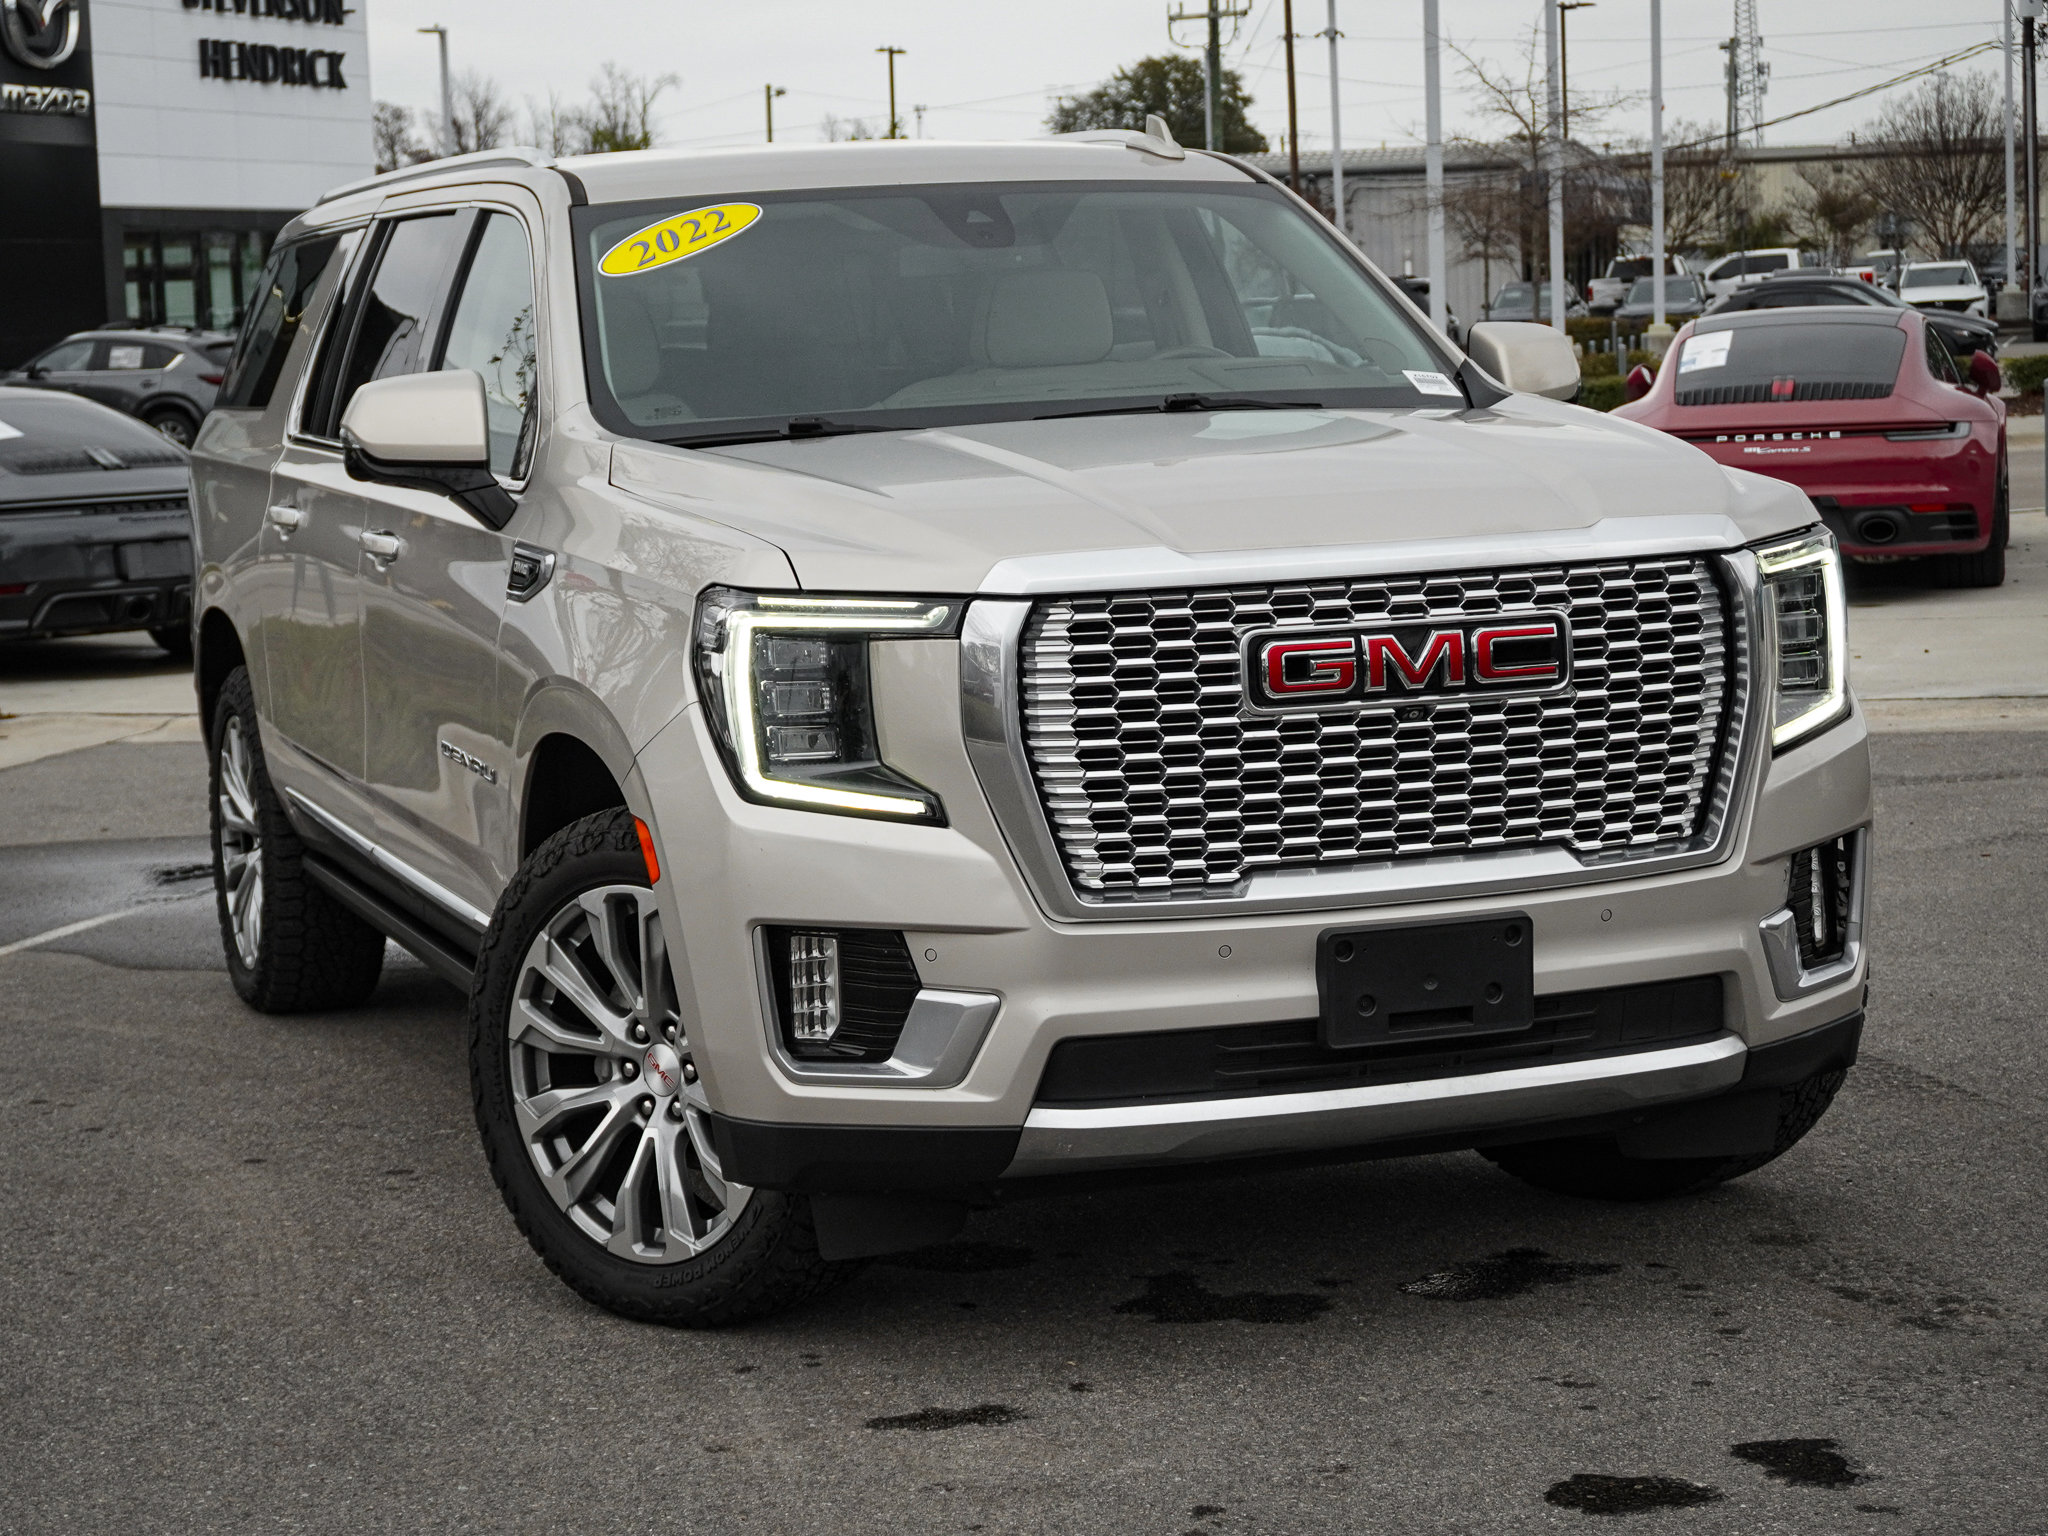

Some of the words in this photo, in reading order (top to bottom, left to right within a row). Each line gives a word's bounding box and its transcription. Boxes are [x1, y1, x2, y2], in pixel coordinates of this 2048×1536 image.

[198, 38, 347, 89] HENDRICK
[1, 83, 91, 113] mazda
[629, 210, 731, 267] 2022
[1716, 431, 1841, 443] PORSCHE
[1261, 622, 1558, 698] GMC
[647, 1052, 676, 1089] GMC
[653, 1267, 704, 1288] POWER
